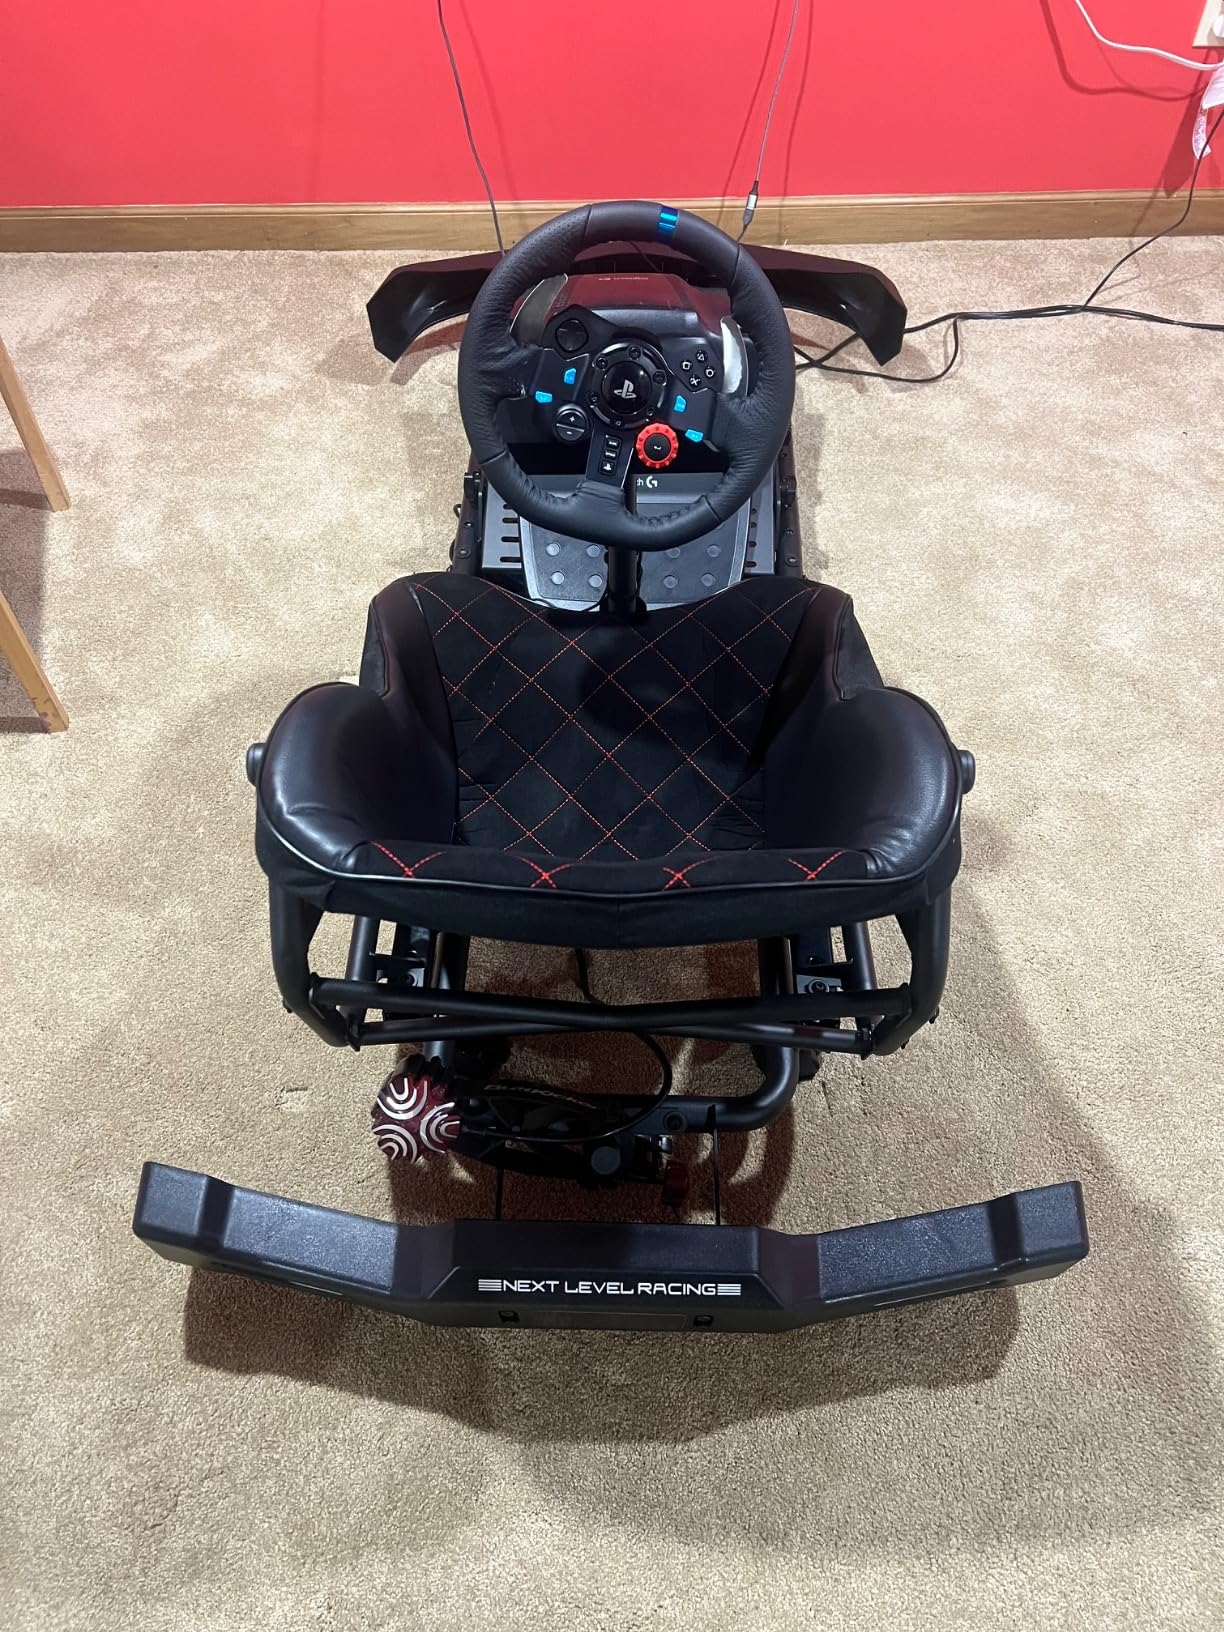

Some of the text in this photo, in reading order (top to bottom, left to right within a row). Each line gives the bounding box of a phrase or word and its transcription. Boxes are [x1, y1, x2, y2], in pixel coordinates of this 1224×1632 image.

[503, 1279, 716, 1296] NEXT LEVEL RACING
